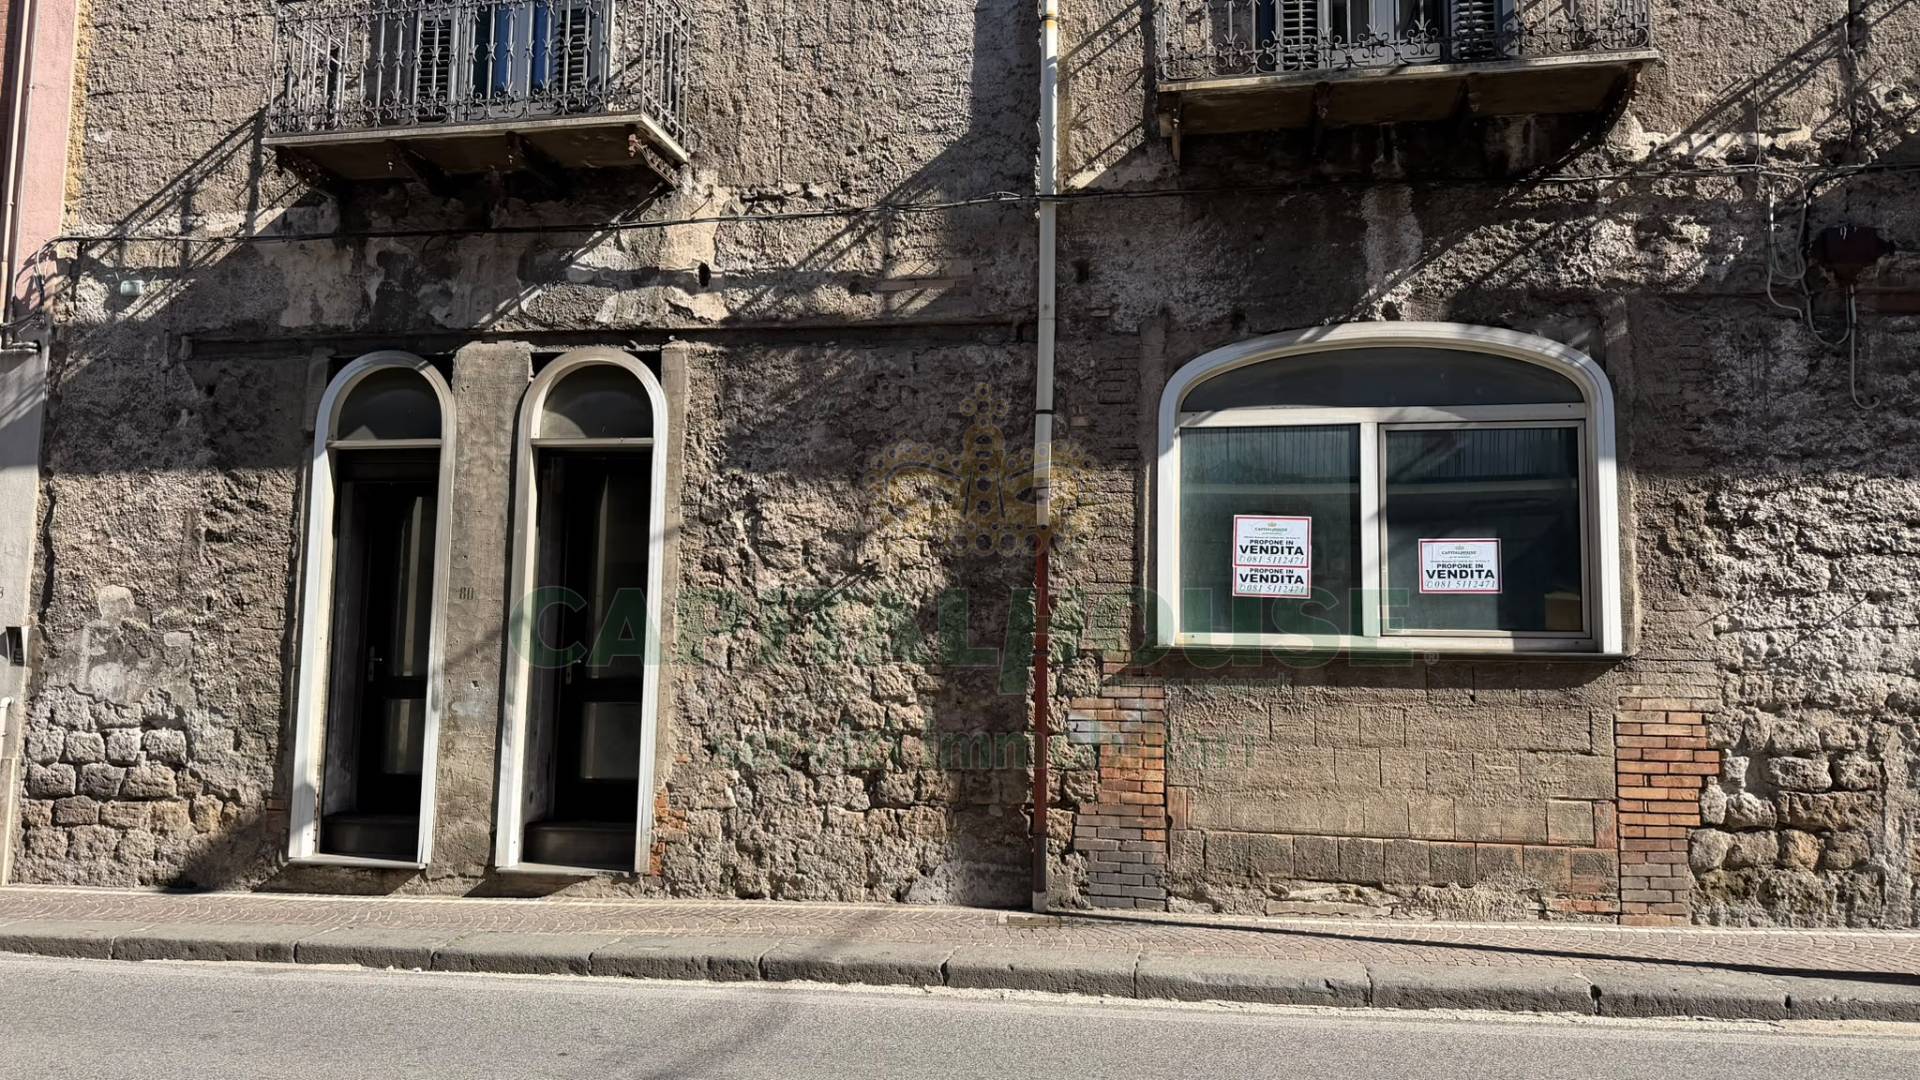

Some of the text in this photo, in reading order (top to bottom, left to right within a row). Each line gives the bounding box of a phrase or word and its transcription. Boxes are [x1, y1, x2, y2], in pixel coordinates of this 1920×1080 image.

[1239, 545, 1304, 555] VENDITA
[1267, 556, 1305, 564] 5112471
[1239, 573, 1304, 584] VENDITA
[1426, 569, 1495, 579] VENDITA
[1434, 580, 1496, 588] 081 5112471
[1267, 585, 1305, 593] 5112471
